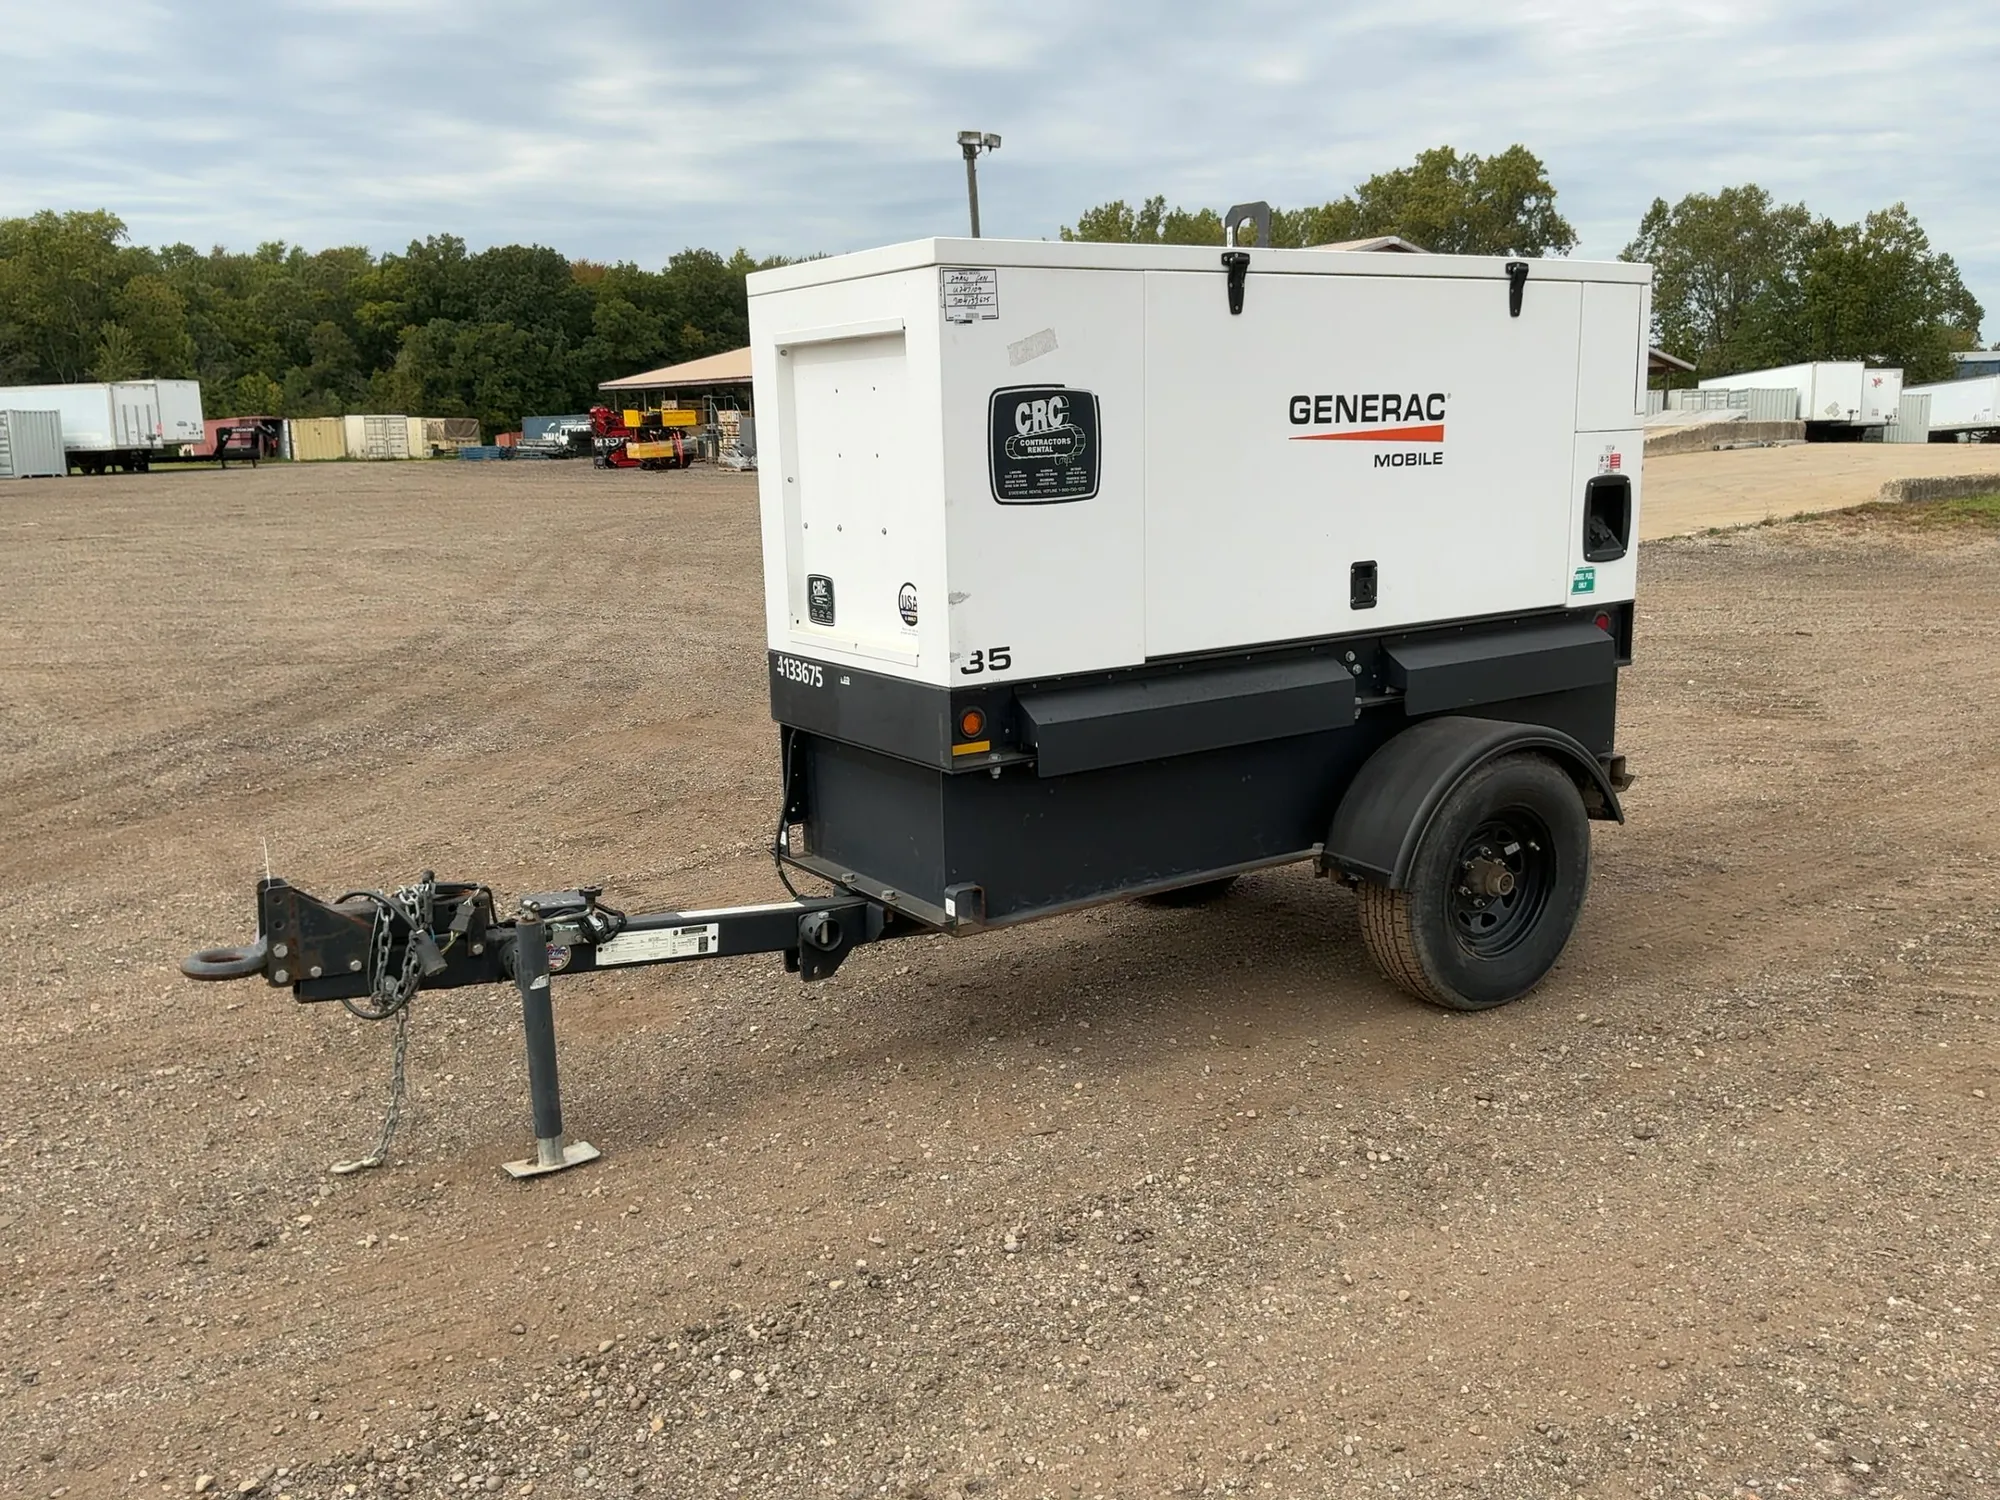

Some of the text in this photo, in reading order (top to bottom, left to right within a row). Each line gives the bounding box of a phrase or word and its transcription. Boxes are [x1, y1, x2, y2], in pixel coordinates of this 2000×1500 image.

[1015, 395, 1070, 436] CRC
[1289, 393, 1446, 425] GENERAC
[1020, 438, 1071, 446] CONTRACTORS
[1027, 446, 1054, 454] RENTAL
[1373, 451, 1443, 468] MOBILE
[901, 594, 918, 612] USA
[776, 655, 824, 688] 4133675
[961, 646, 1011, 674] 35
